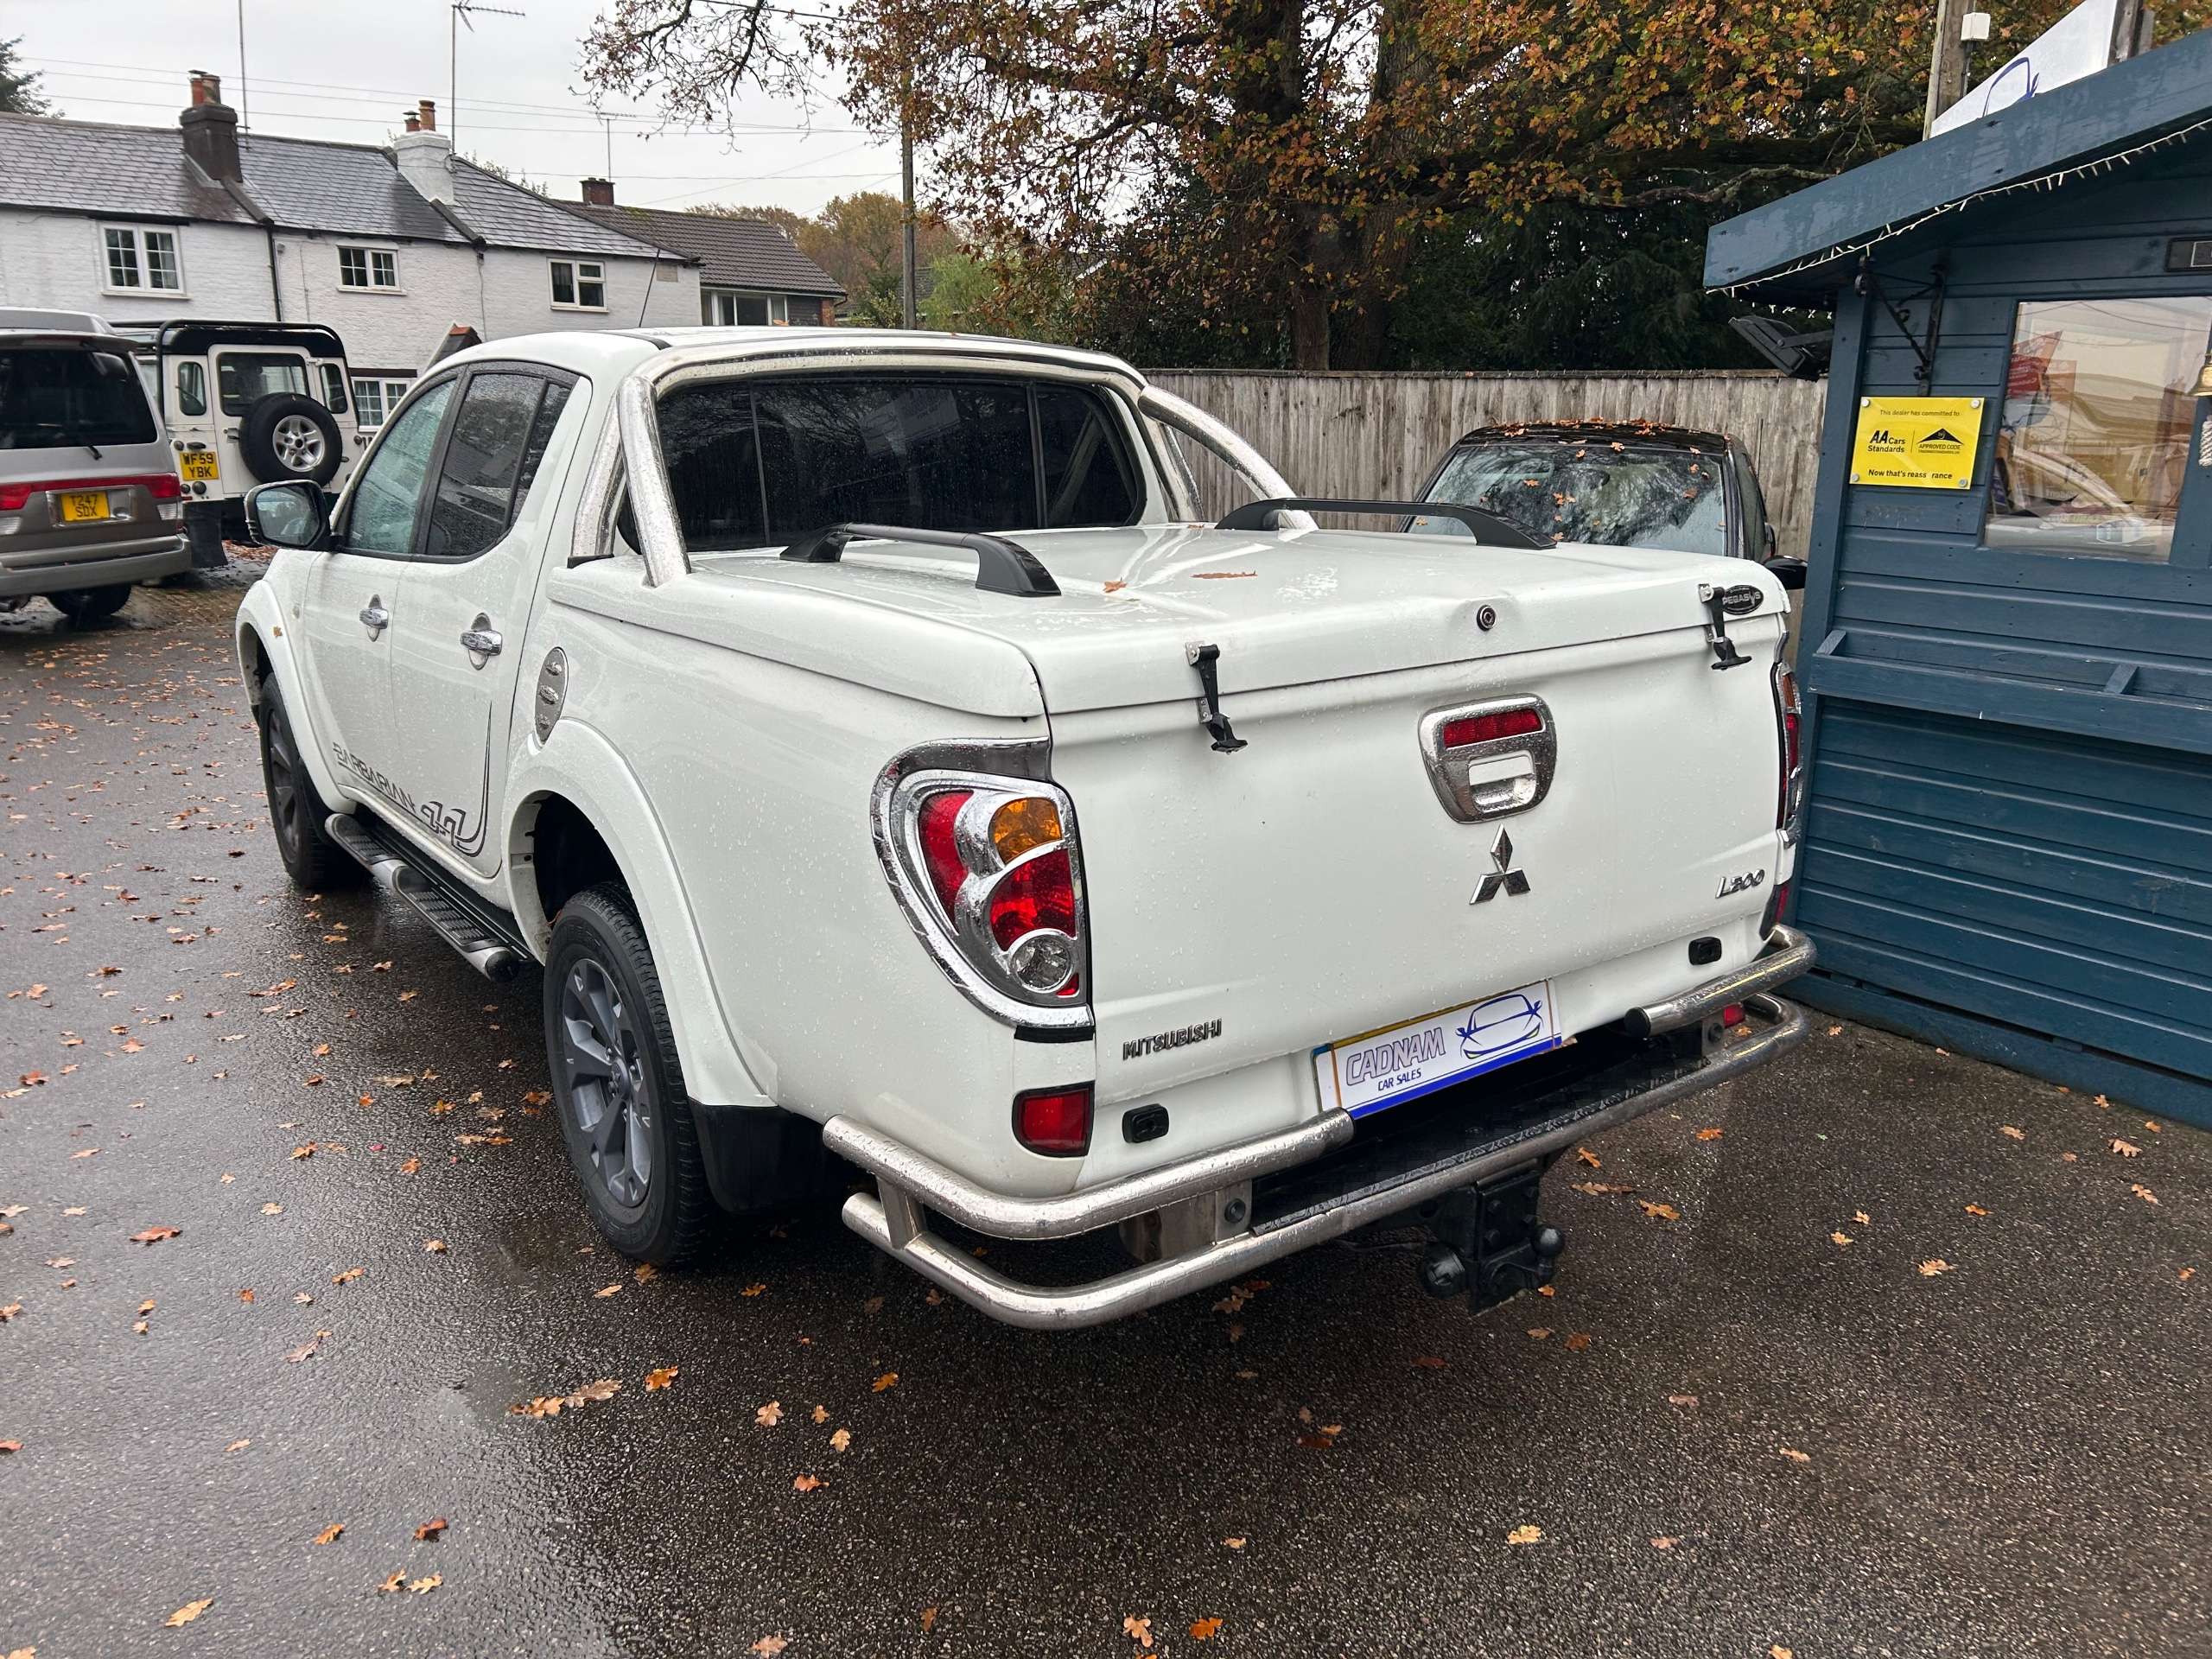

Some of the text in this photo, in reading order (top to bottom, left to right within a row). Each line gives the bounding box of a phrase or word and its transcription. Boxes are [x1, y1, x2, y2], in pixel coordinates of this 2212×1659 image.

[1869, 429, 1906, 445] AA Cars
[183, 453, 214, 465] WF59
[189, 467, 213, 478] YBK
[1885, 469, 1906, 478] that's
[69, 493, 98, 506] T247
[1715, 869, 1765, 899] L200
[1122, 1018, 1223, 1061] MITSUBISHI
[1346, 1027, 1446, 1086] CADNAM
[1378, 1067, 1421, 1091] CAR SALES
